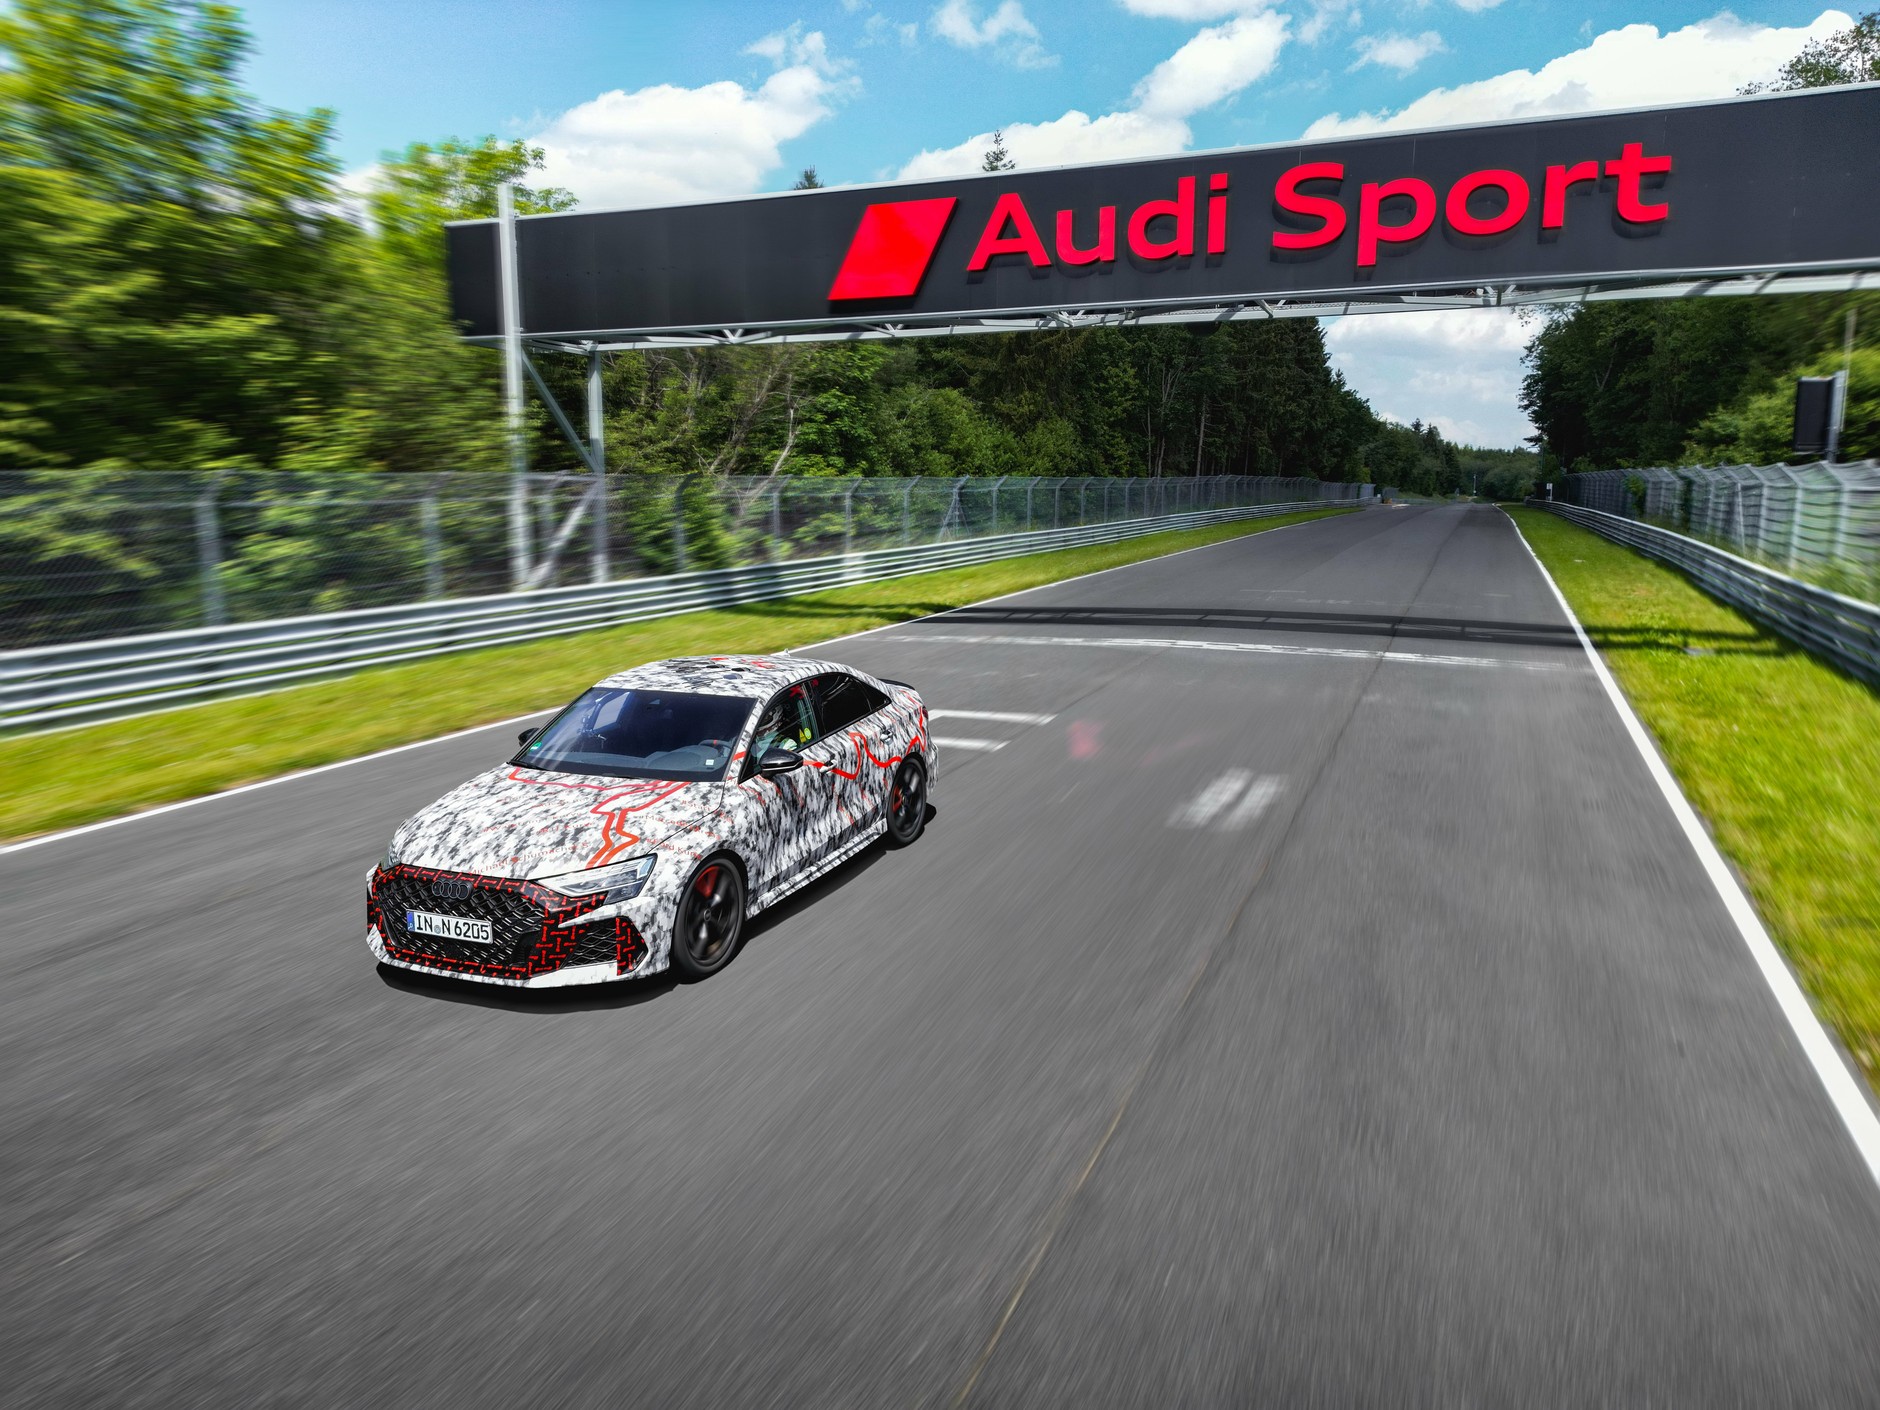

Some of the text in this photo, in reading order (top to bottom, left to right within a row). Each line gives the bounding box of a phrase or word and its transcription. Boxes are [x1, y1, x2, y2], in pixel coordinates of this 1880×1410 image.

[967, 142, 1673, 272] Audi Sport
[416, 914, 433, 932] IN
[441, 918, 451, 935] N
[454, 921, 490, 941] 6205
